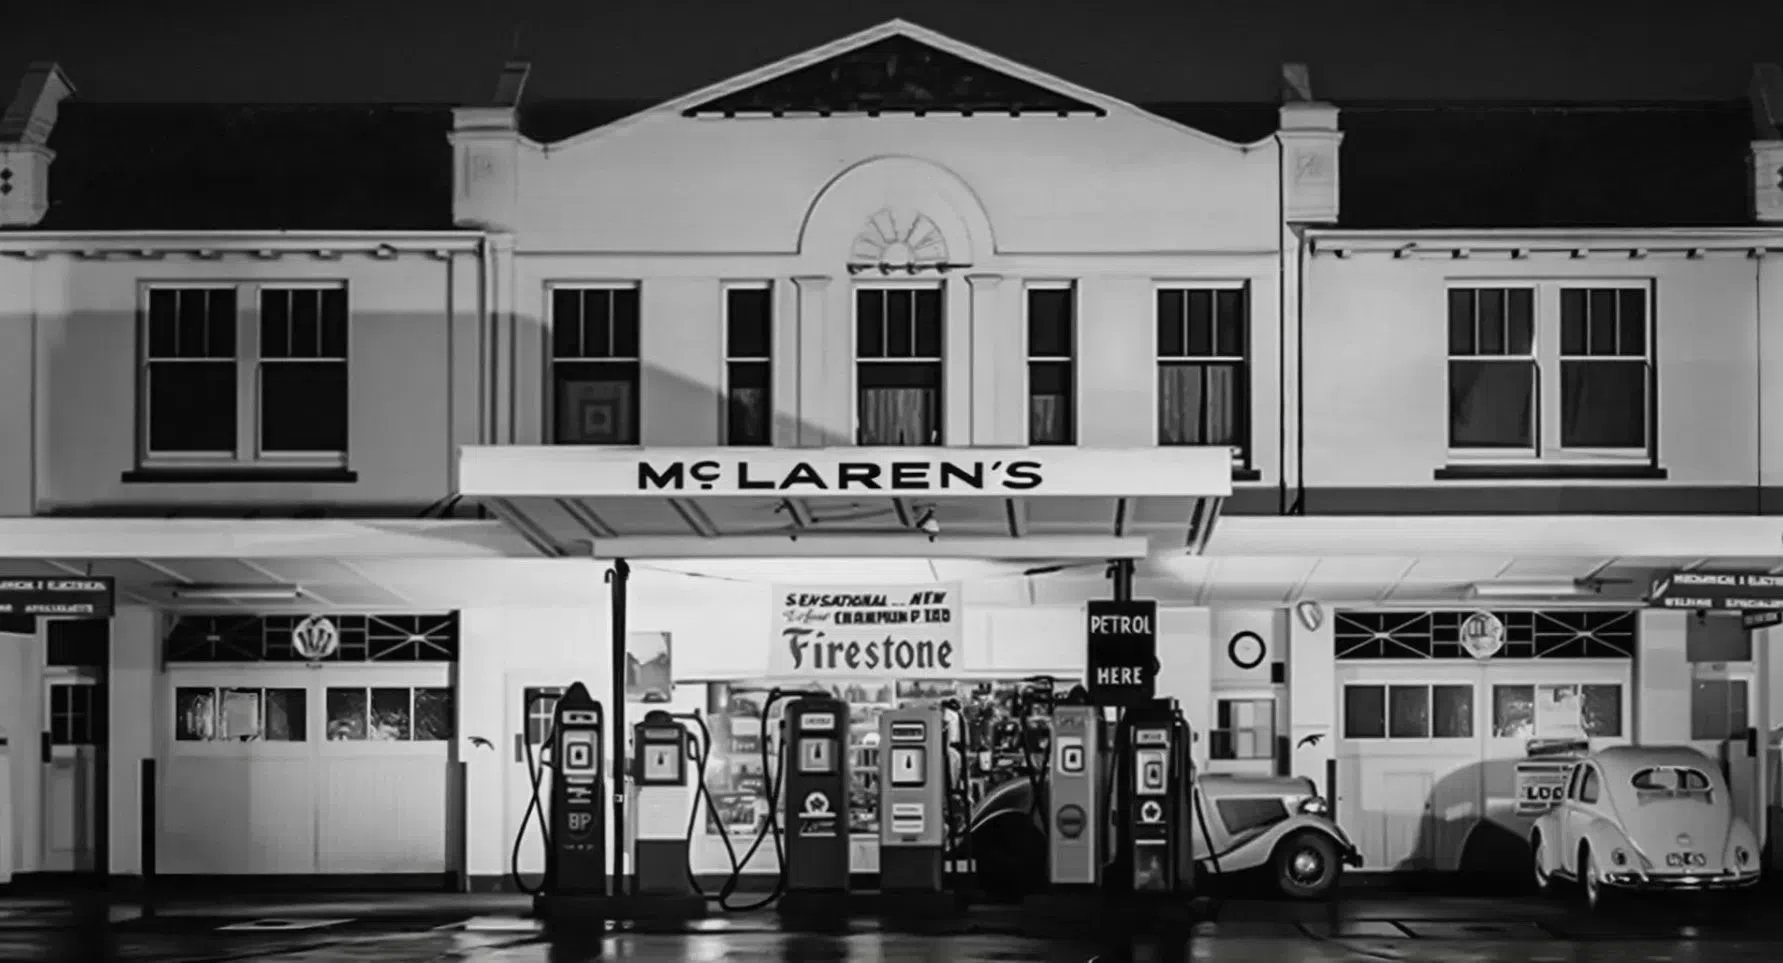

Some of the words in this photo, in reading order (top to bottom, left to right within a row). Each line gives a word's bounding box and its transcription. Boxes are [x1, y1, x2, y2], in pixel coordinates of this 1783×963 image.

[785, 592, 888, 607] SENSATIONAL
[909, 590, 947, 606] NEW
[1090, 614, 1152, 635] PETROL
[782, 627, 953, 670] Firestone
[1097, 666, 1143, 685] HERE
[568, 812, 592, 831] BP
